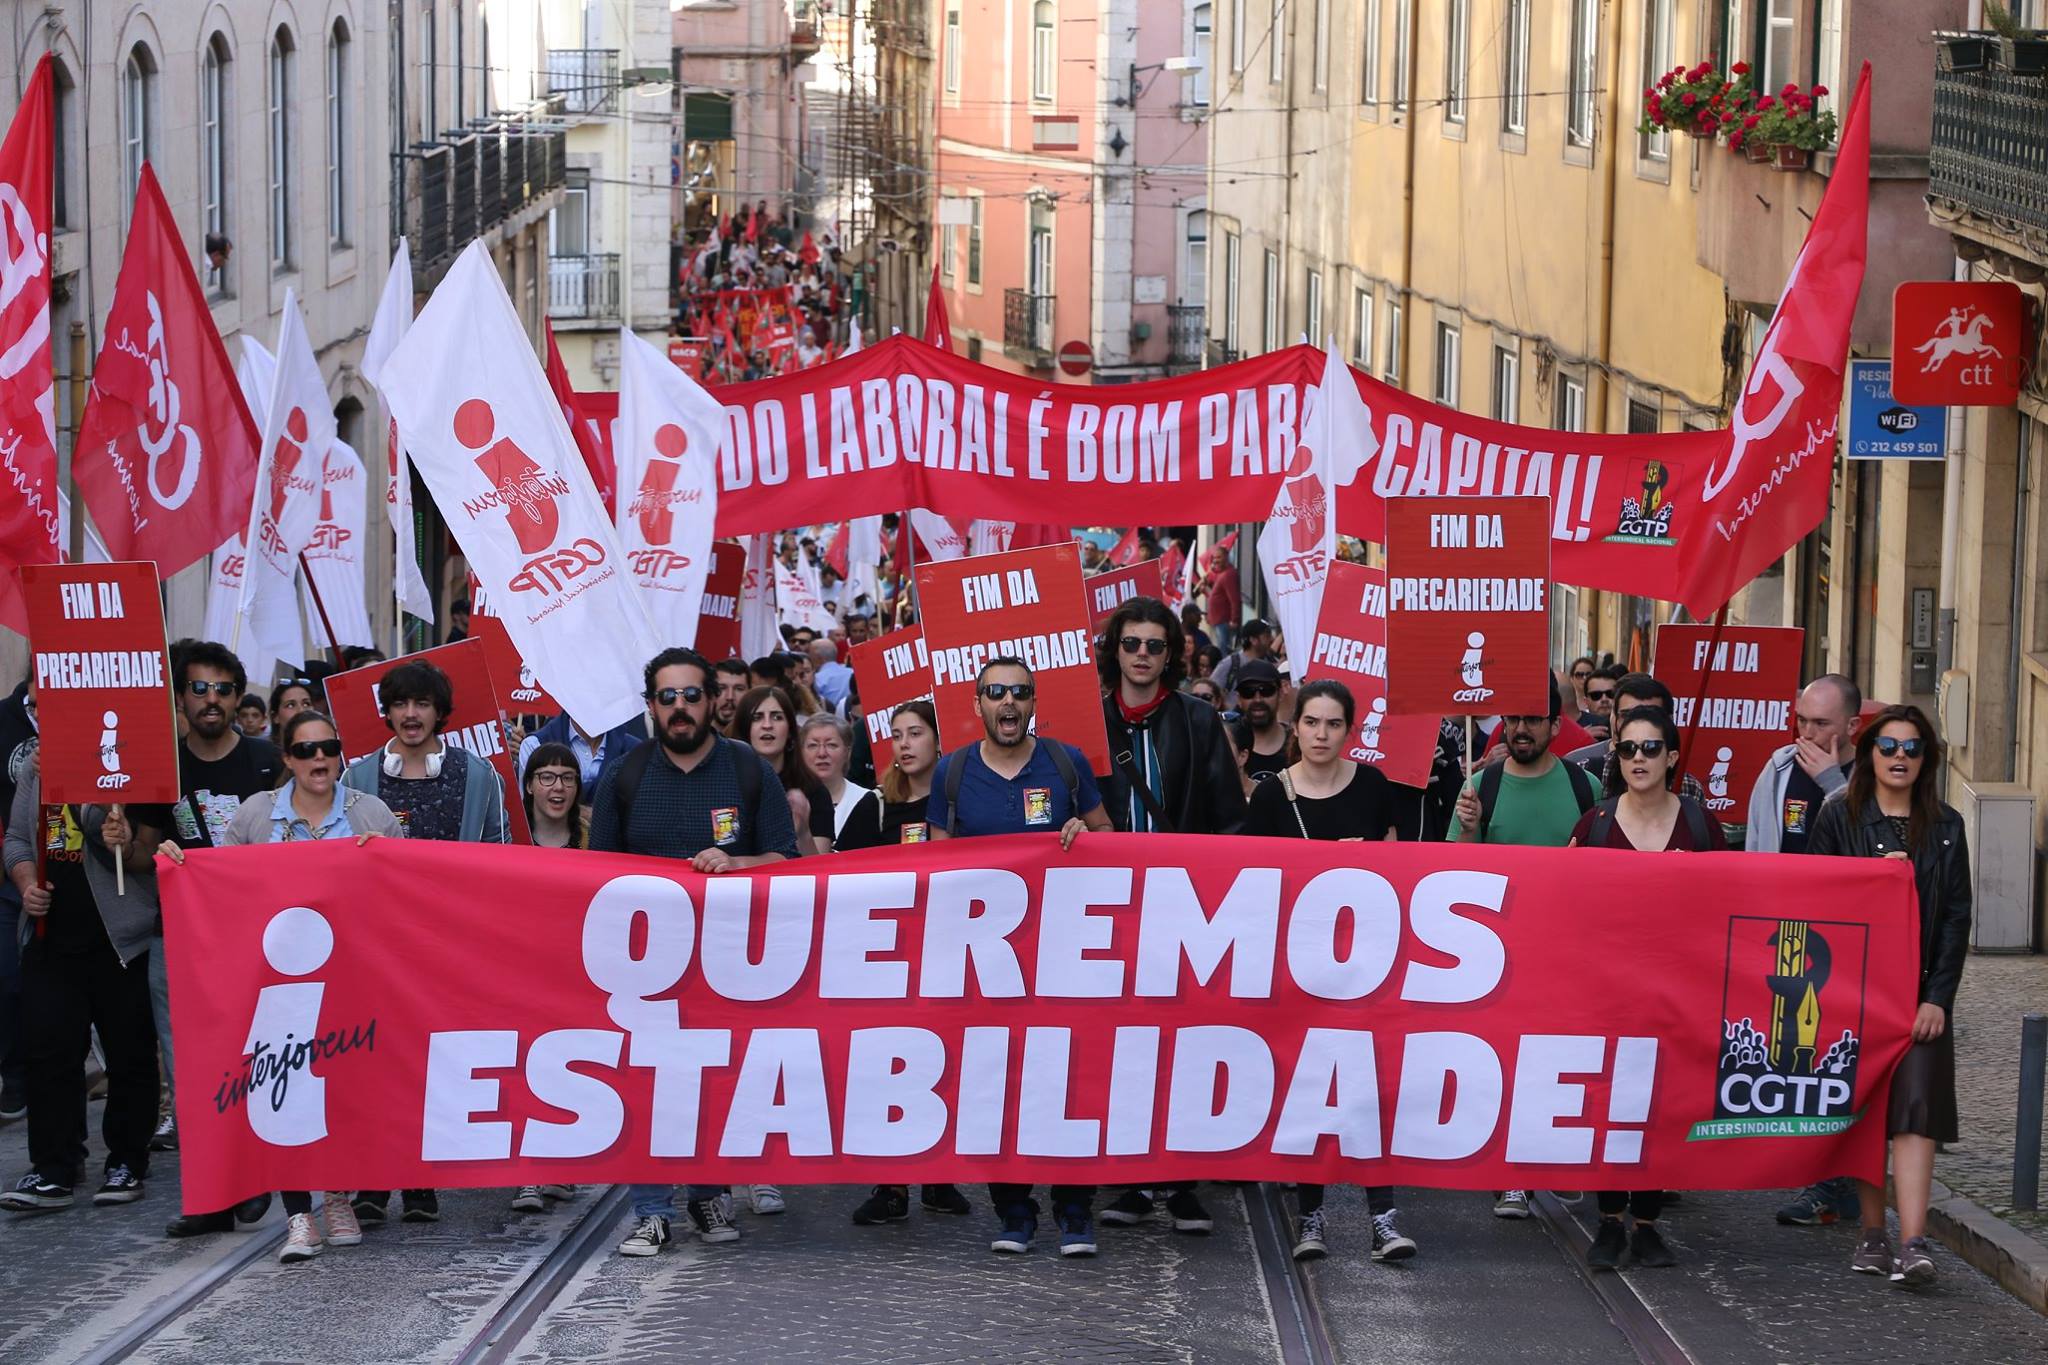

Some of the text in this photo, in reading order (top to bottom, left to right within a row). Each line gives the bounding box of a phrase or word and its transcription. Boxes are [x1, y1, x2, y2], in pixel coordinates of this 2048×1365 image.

[1959, 364, 1993, 385] ctt
[800, 373, 1014, 479] LABORAL
[1028, 391, 1053, 480] É
[1067, 400, 1183, 483] BOM
[1871, 442, 1938, 453] 212 459 501
[1430, 514, 1504, 548] FIM DA
[1618, 519, 1668, 538] CGTP
[60, 581, 125, 620] FIM DA
[961, 568, 1040, 613] FIM DA
[1095, 583, 1118, 613] FIM
[1389, 577, 1545, 612] PRECARIEDADE
[36, 651, 164, 689] PRECARIEDADE
[883, 643, 915, 680] FIM
[1732, 642, 1759, 673] DA
[1452, 687, 1495, 703] CGTP
[96, 772, 131, 789] CGTP
[581, 866, 1509, 1010] QUEREMOS
[215, 1018, 376, 1114] interjovem
[420, 1024, 1659, 1165] ESTABILIDADE!
[1719, 1072, 1851, 1117] CGTP
[1696, 1118, 1850, 1136] INTERSINDICAL NACION
